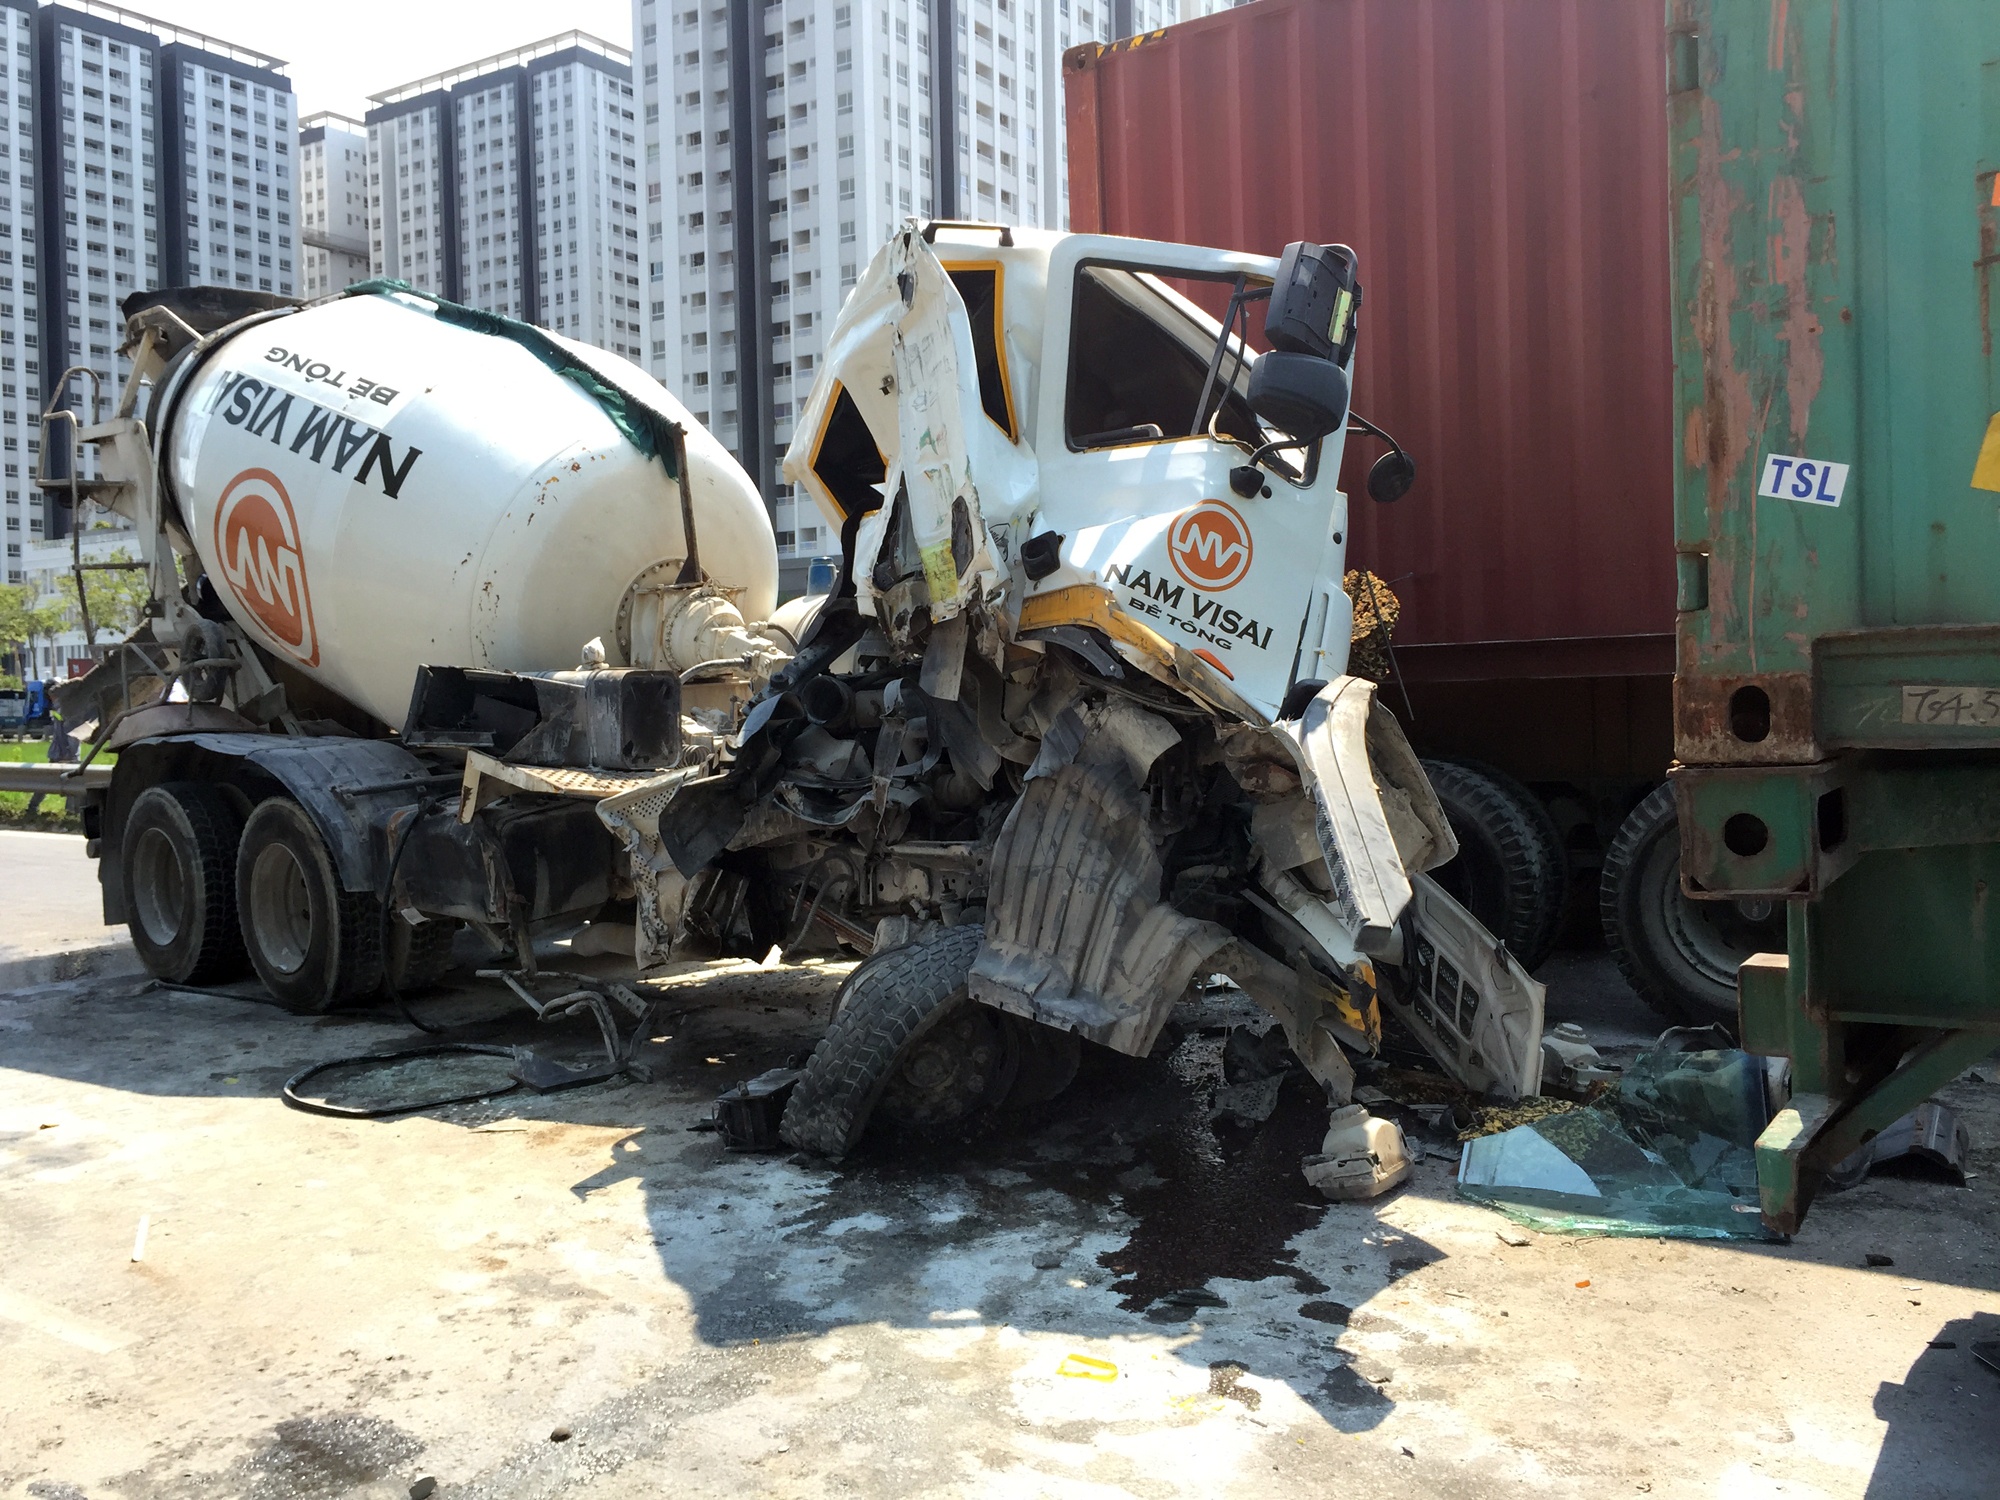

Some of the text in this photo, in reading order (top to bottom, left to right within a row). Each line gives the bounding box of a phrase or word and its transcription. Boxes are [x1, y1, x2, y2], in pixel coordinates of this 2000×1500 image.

[263, 346, 347, 388] TÔNG
[288, 404, 424, 500] NAM
[1771, 458, 1836, 503] TSL
[1103, 563, 1274, 651] NAM VISAI
[1128, 597, 1233, 651] BÊ TÔNG
